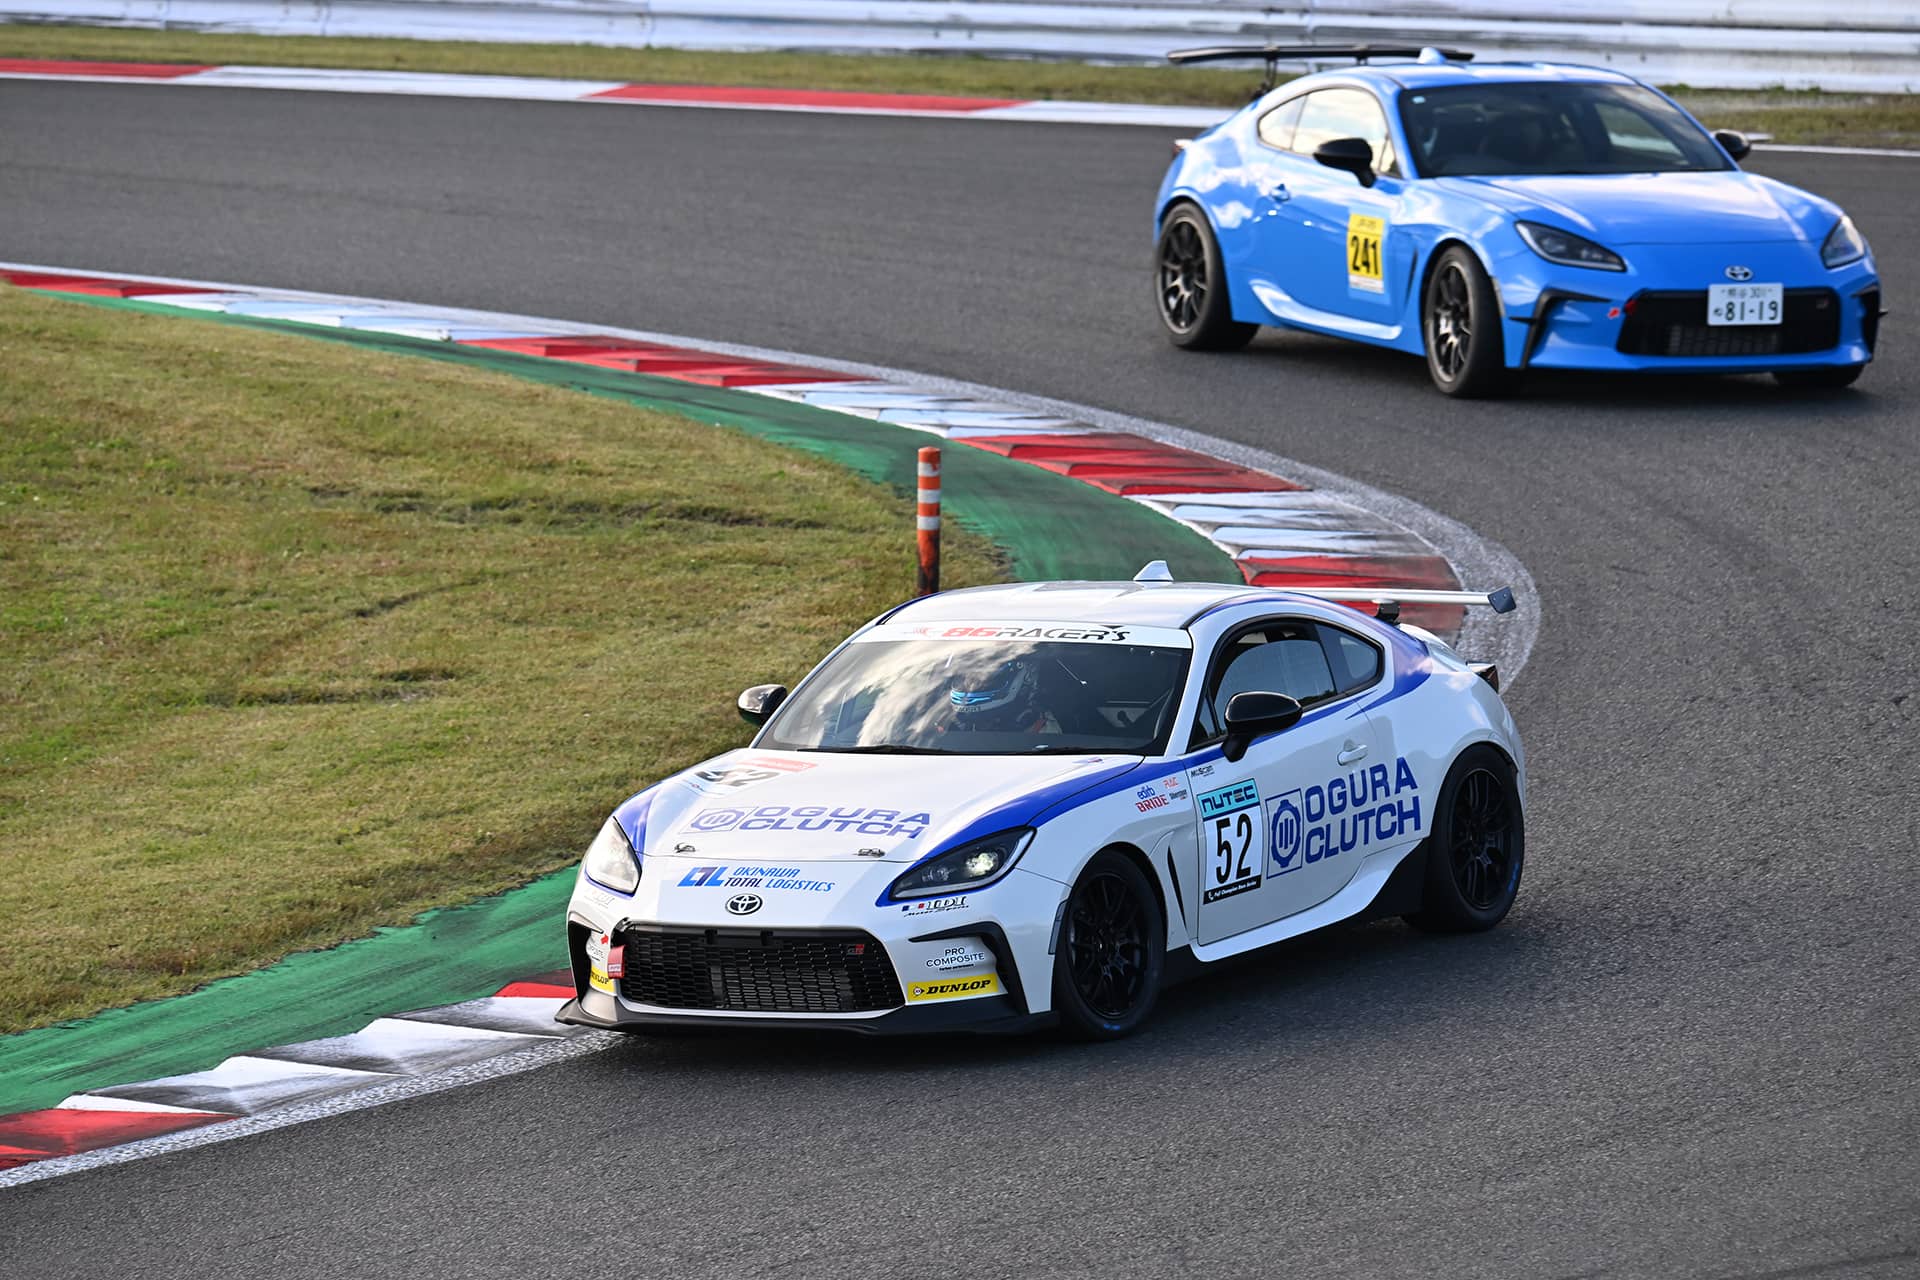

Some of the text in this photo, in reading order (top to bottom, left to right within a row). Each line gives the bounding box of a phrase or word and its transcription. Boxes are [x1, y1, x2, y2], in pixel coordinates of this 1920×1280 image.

[1350, 235, 1378, 275] 241
[1201, 785, 1256, 812] NUTEC
[1304, 757, 1418, 823] OGURA
[1135, 794, 1170, 812] BRIDE
[753, 806, 931, 825] OGURA
[738, 818, 926, 839] CLUTCH
[1304, 796, 1421, 864] CLUTCH
[1216, 813, 1252, 884] 52
[733, 866, 801, 878] OKINAWA
[724, 877, 836, 892] TOTAL LOGISTICS
[926, 952, 985, 968] COMPOSITE
[945, 947, 966, 957] PRO
[926, 980, 991, 995] DUNLOP
